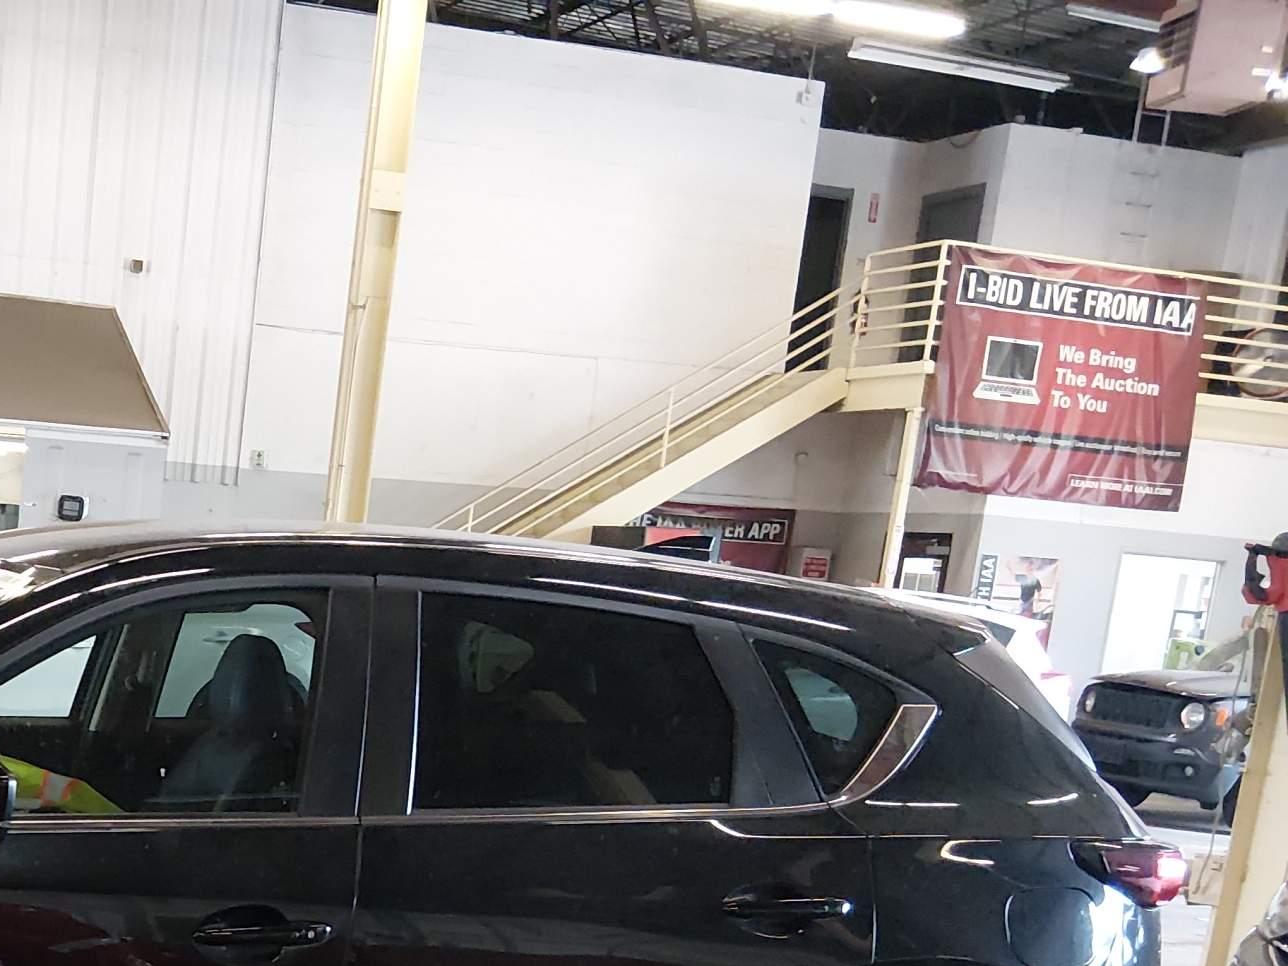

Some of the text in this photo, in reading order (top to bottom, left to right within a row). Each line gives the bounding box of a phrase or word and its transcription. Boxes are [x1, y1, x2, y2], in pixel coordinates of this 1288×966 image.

[966, 271, 1197, 329] I-BID LIVE FROM IAA
[1059, 344, 1137, 374] We Bring
[1055, 367, 1160, 396] The Auction
[1051, 390, 1108, 413] To You
[748, 521, 781, 541] APP
[980, 558, 996, 583] IAA
